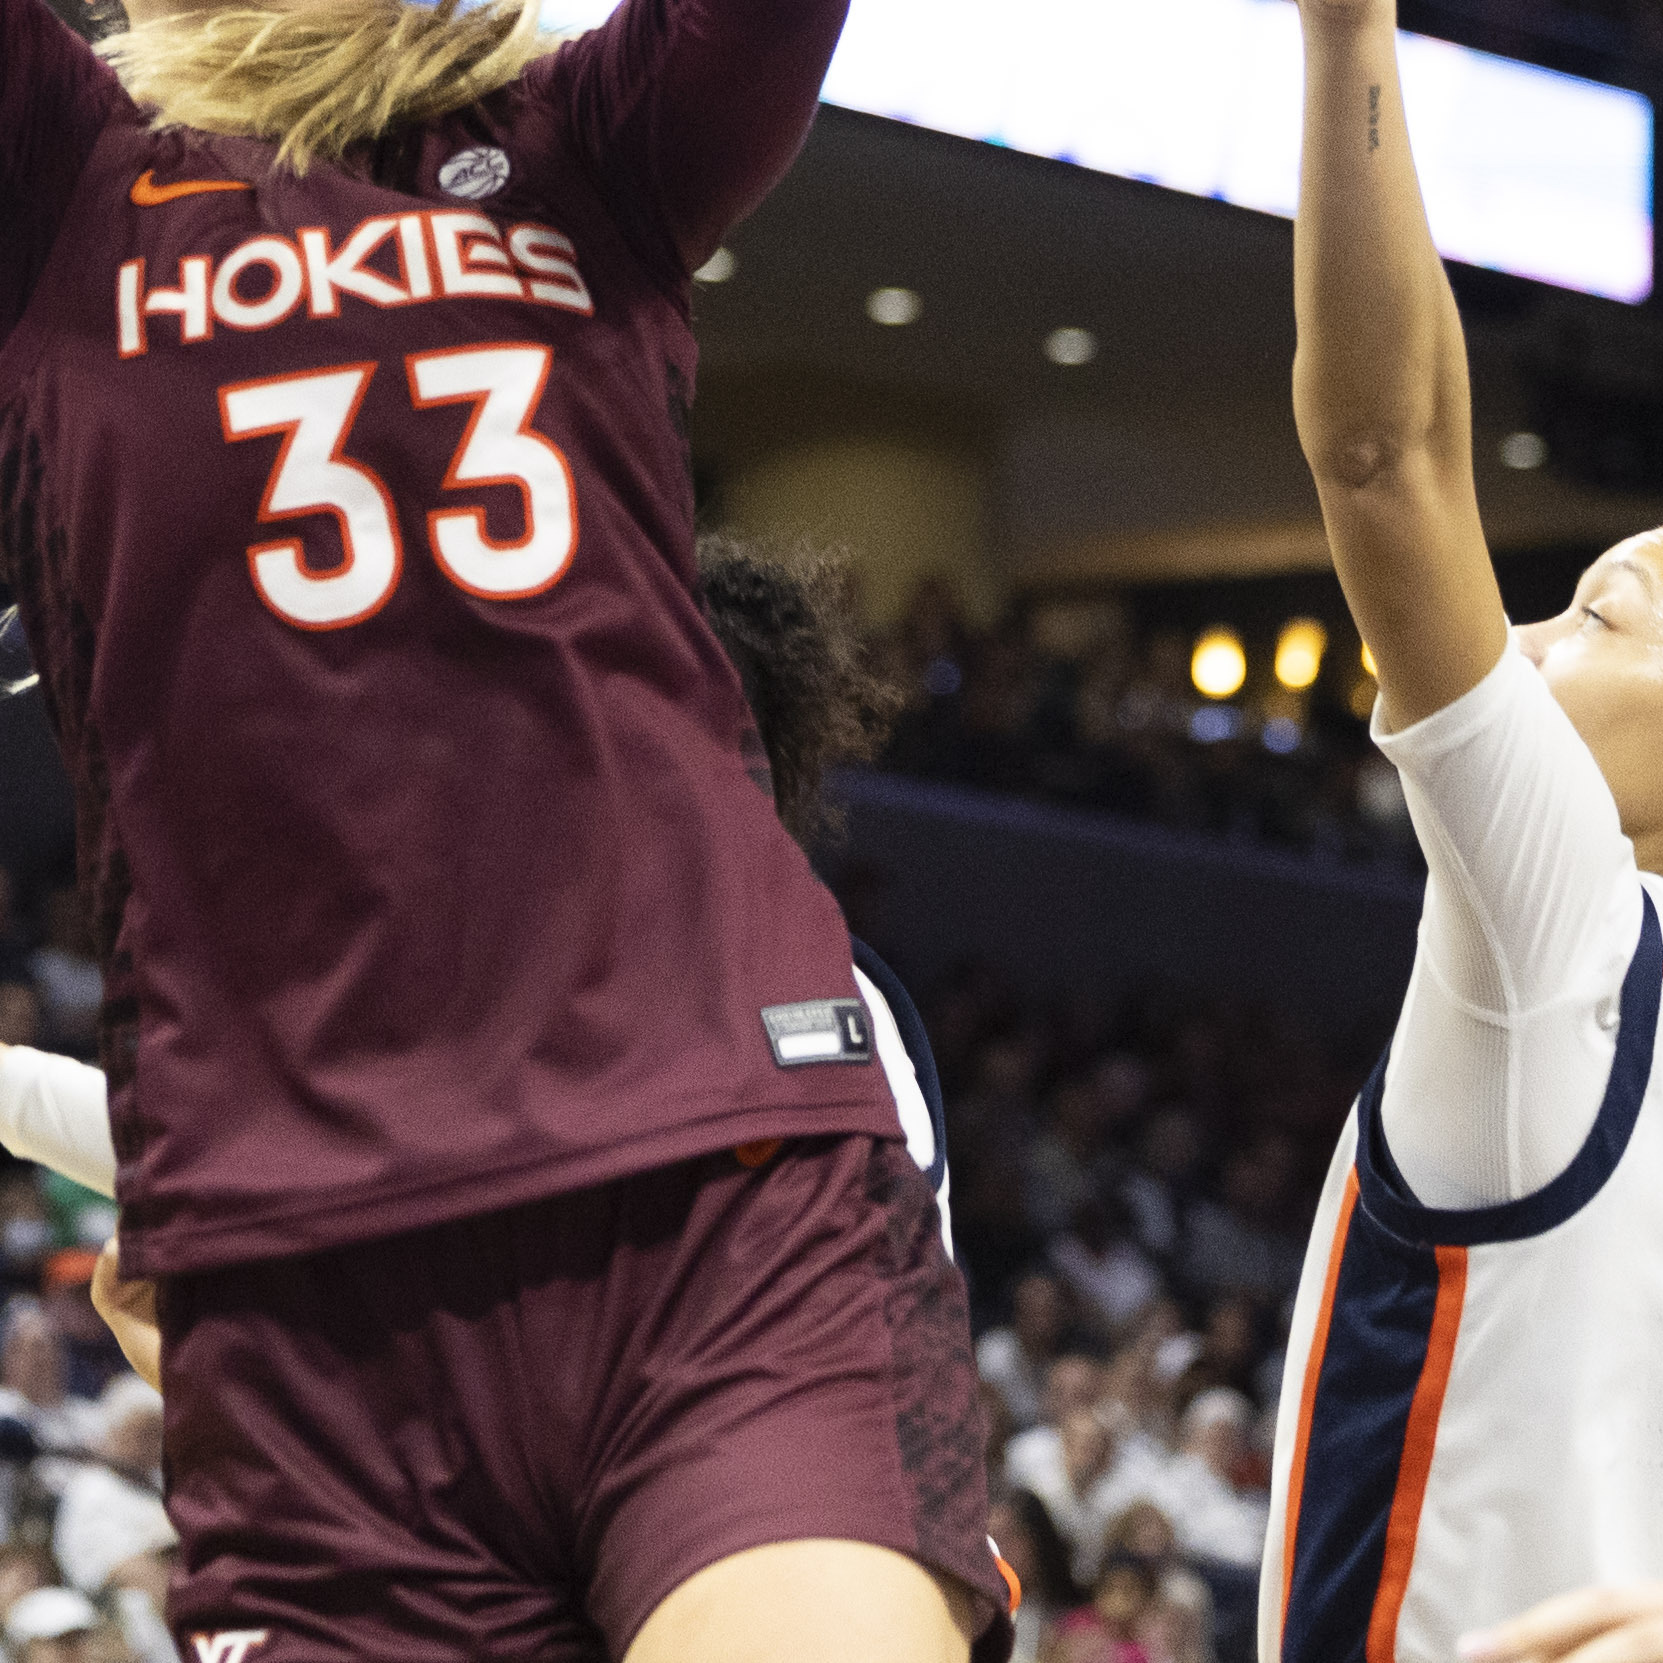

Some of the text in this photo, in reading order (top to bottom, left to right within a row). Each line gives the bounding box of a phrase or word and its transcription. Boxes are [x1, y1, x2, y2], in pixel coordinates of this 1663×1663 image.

[118, 208, 594, 358] HOKIES
[218, 341, 579, 632] 33
[847, 1014, 863, 1044] L
